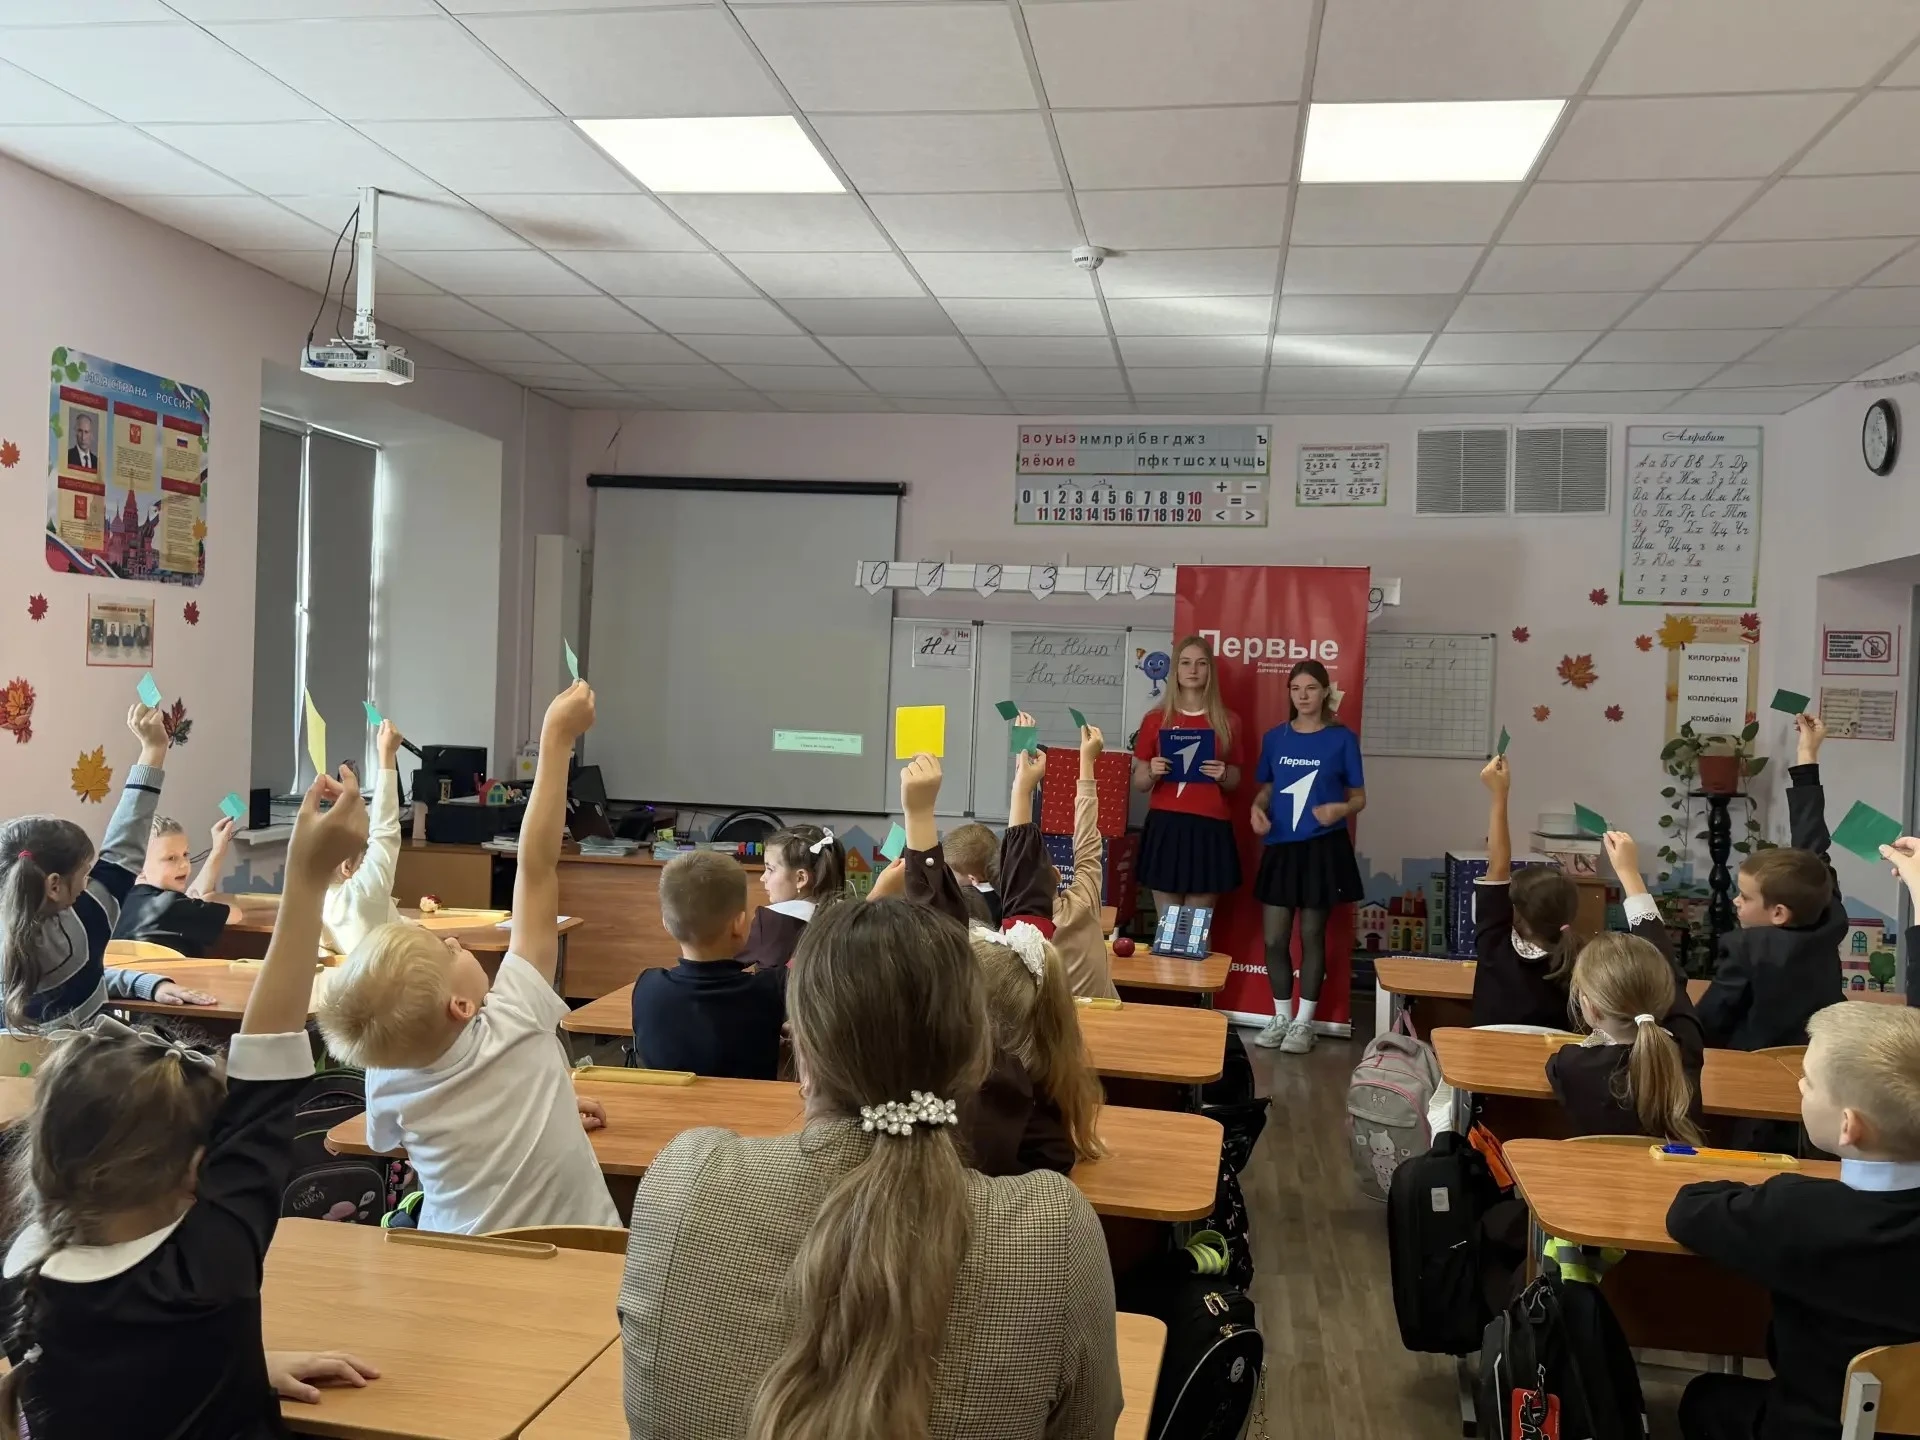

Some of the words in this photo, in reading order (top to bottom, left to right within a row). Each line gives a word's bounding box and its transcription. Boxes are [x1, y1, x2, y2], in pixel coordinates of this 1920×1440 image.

[111, 379, 148, 398] СТРАНА
[156, 392, 191, 411] РОССИЯ
[1662, 428, 1725, 444] Алфавит
[1023, 490, 1031, 504] 0
[1043, 490, 1049, 504] 1
[1058, 490, 1066, 504] 2
[1075, 490, 1083, 504] 3
[1091, 490, 1100, 504] 4
[1108, 490, 1116, 504] 5
[1125, 490, 1134, 504] 6
[1144, 490, 1151, 504] 7
[1160, 490, 1168, 504] 8
[1177, 490, 1185, 504] 9
[1188, 490, 1202, 504] 10
[1038, 508, 1048, 521] 11
[1053, 508, 1066, 521] 12
[1069, 508, 1082, 521] 13
[1086, 508, 1099, 521] 14
[1102, 508, 1116, 521] 15
[1119, 508, 1133, 521] 16
[1137, 508, 1150, 521] 17
[1153, 508, 1167, 521] 18
[1170, 508, 1184, 521] 19
[1187, 508, 1201, 521] 20
[870, 560, 888, 585] 0
[927, 562, 944, 586] 1
[984, 564, 1002, 588] 2
[1038, 566, 1057, 590] 3
[1096, 566, 1112, 590] 4
[1138, 567, 1160, 590] 5
[1368, 587, 1384, 612] 9
[1199, 629, 1338, 665] Первые
[1688, 654, 1741, 663] килограмм
[1688, 674, 1738, 683] коллектив
[1687, 695, 1738, 703] коллекция
[1170, 734, 1201, 742] Первые
[1279, 756, 1321, 768] Первые
